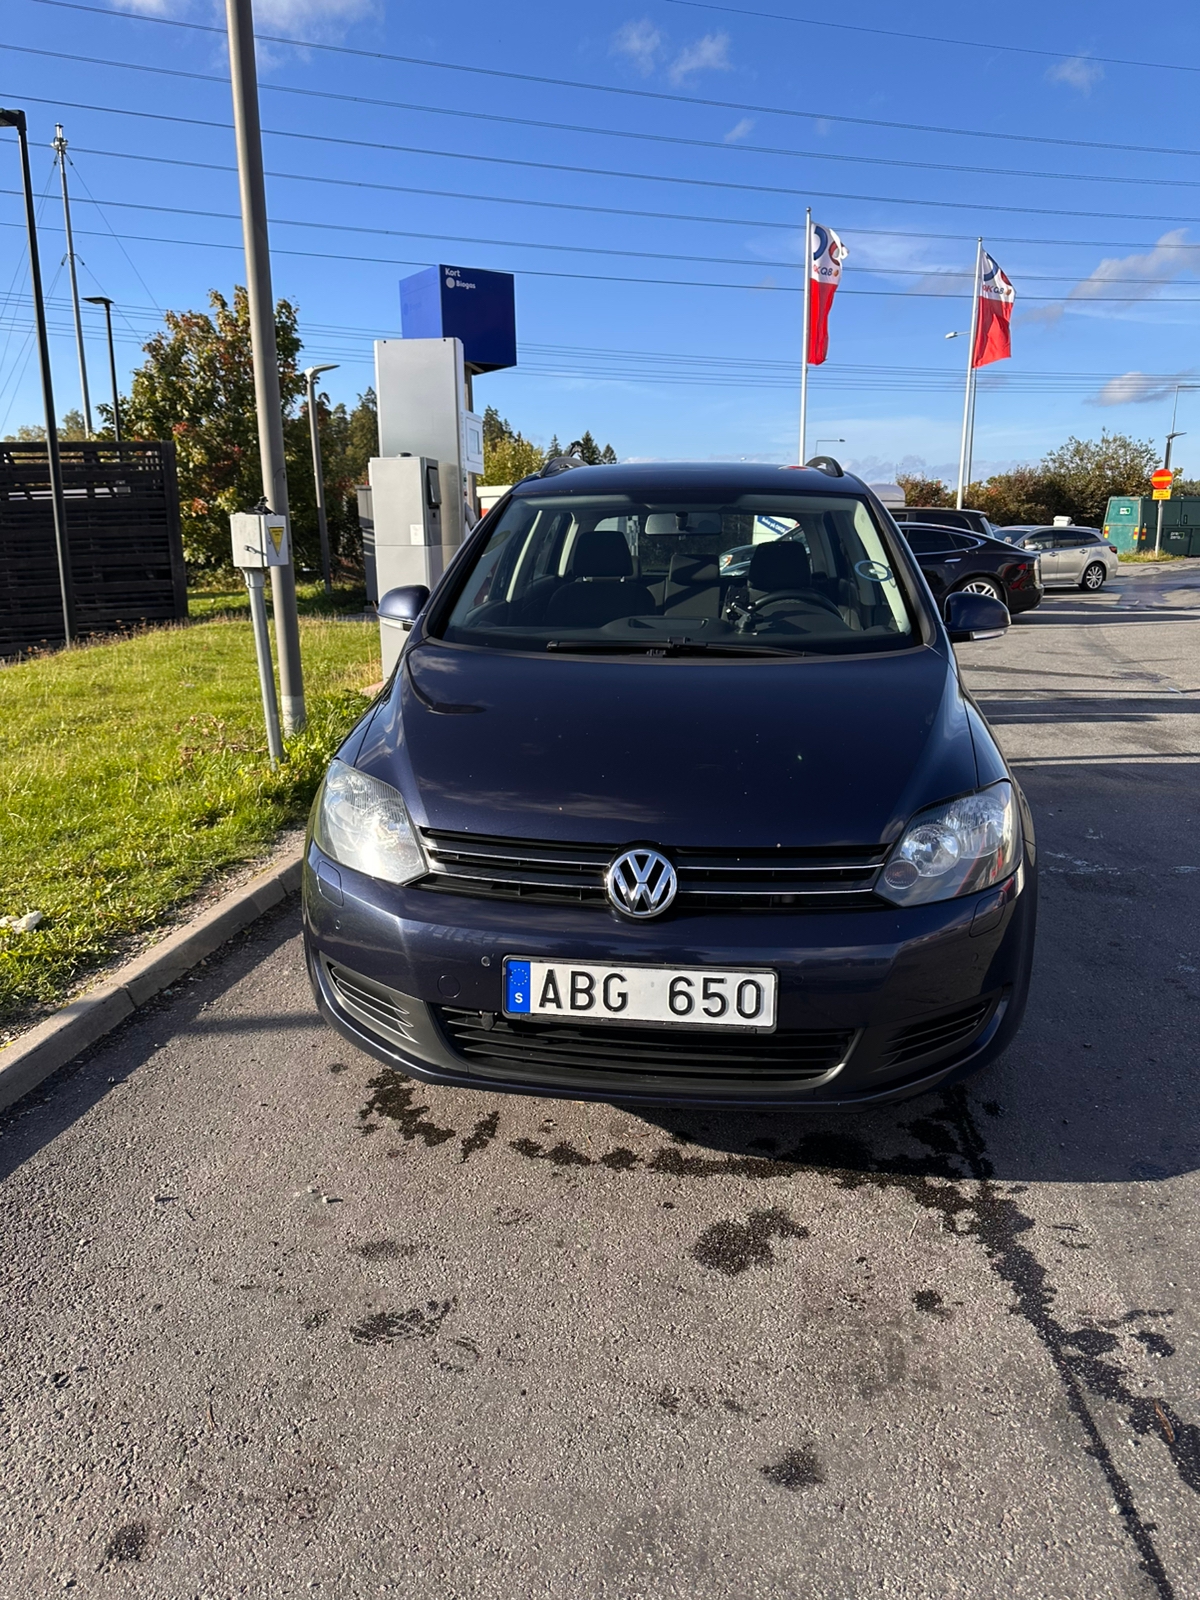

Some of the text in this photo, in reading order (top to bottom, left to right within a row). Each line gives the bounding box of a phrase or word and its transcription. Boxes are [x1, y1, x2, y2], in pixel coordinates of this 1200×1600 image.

[445, 267, 461, 277] Kort
[456, 280, 476, 290] Biogas
[515, 992, 523, 1004] S
[538, 968, 761, 1019] ABG 650
